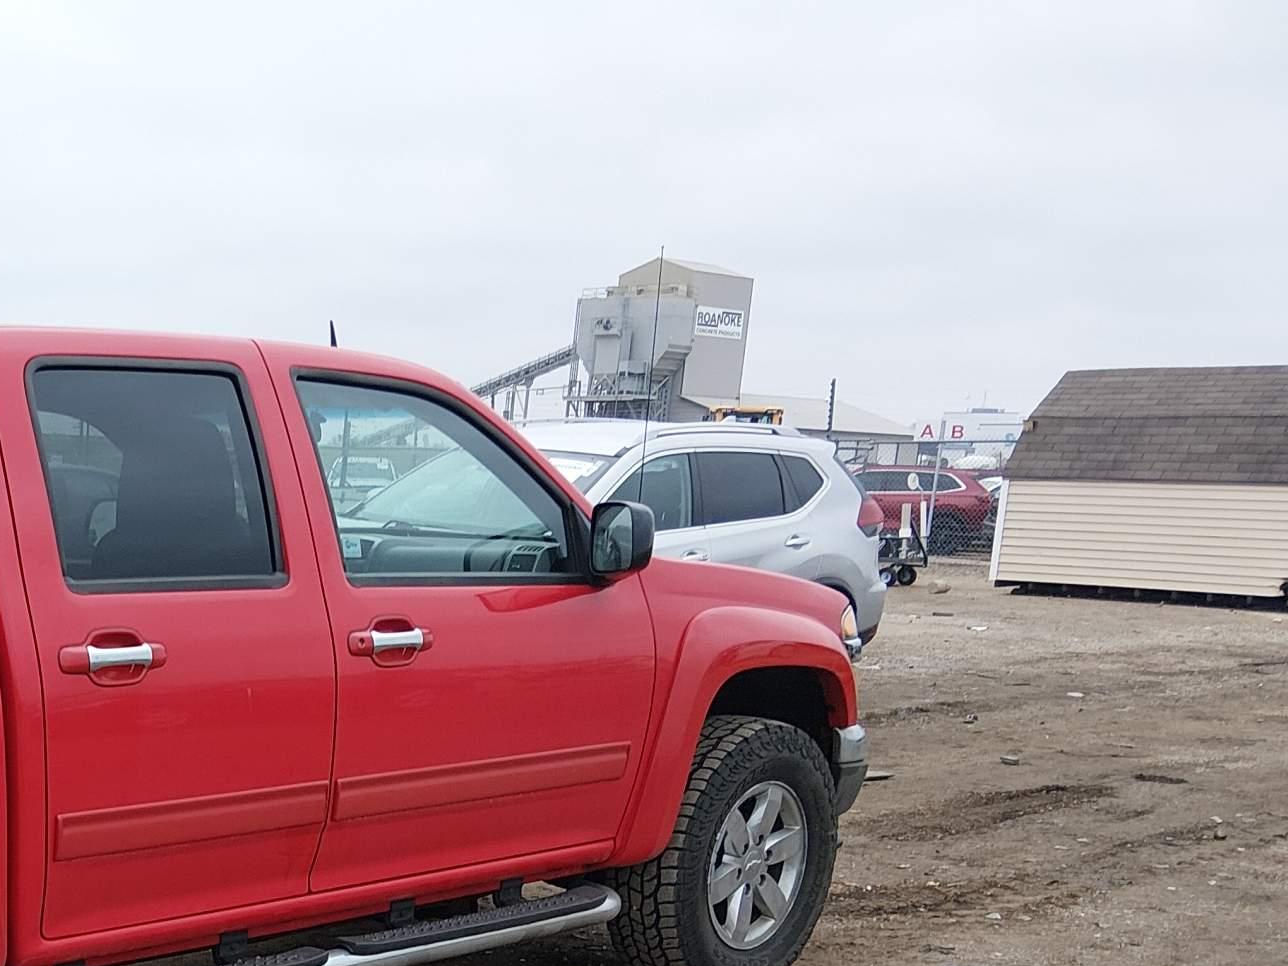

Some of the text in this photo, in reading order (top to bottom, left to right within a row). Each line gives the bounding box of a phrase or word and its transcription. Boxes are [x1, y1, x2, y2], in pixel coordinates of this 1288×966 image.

[697, 311, 742, 327] ROANOKE
[696, 328, 741, 338] CONCRETE PRODUCTS
[920, 424, 964, 439] A B
